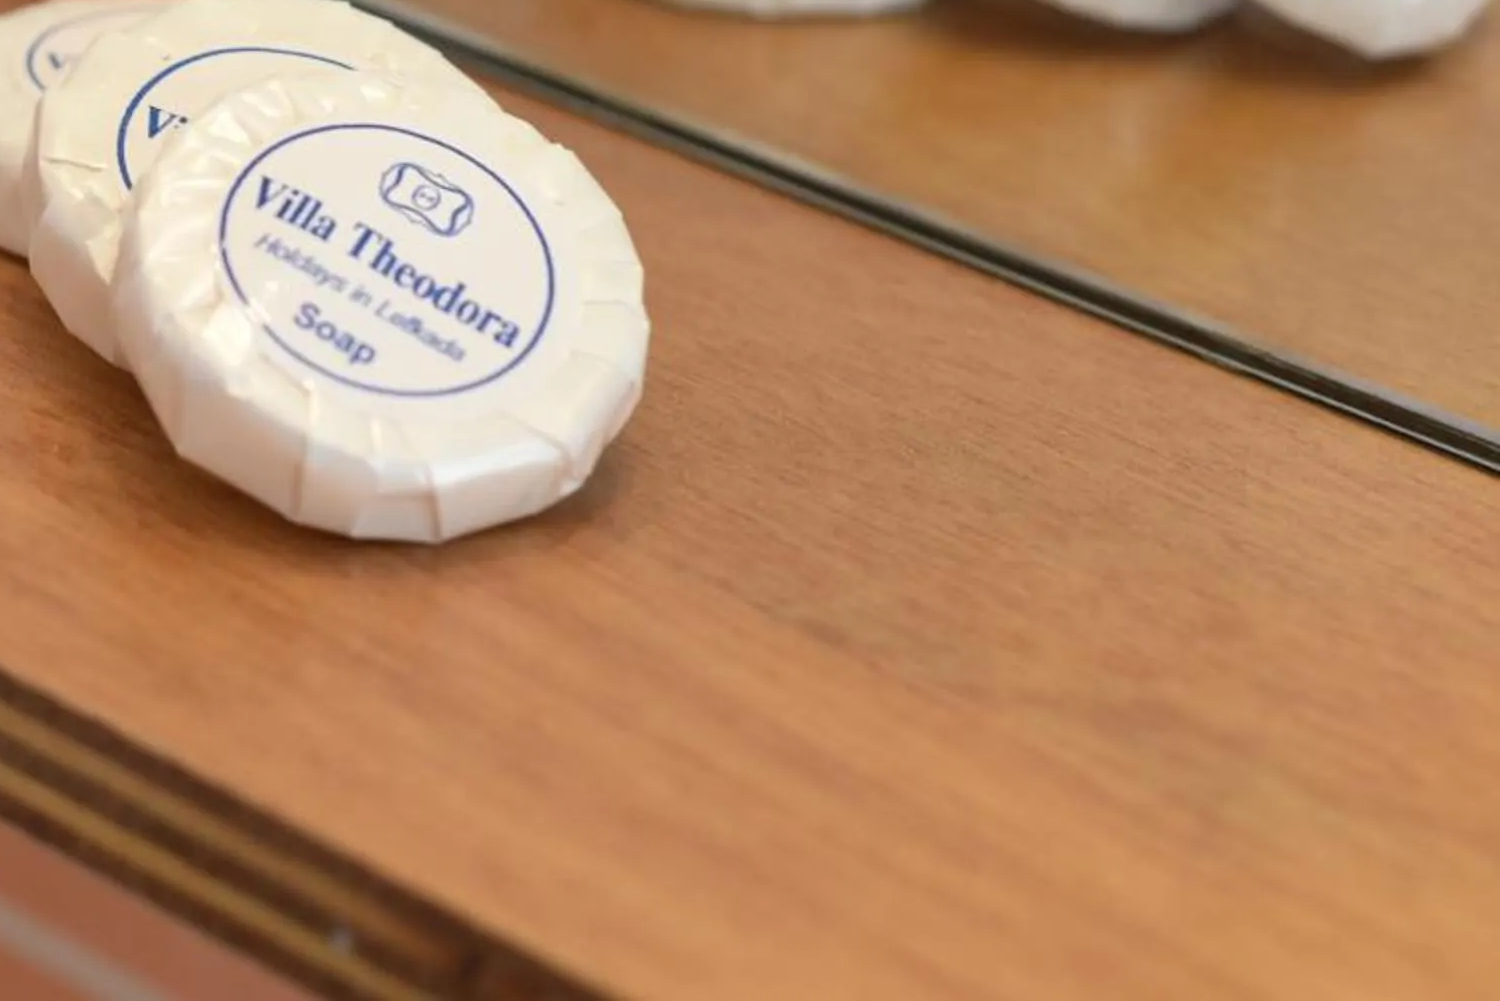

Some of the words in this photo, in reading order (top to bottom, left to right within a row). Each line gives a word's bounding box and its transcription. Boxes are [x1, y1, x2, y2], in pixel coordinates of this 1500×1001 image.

[252, 175, 337, 242] Villa
[346, 221, 521, 348] Theodora
[348, 284, 373, 308] in
[292, 302, 377, 365] Soap
